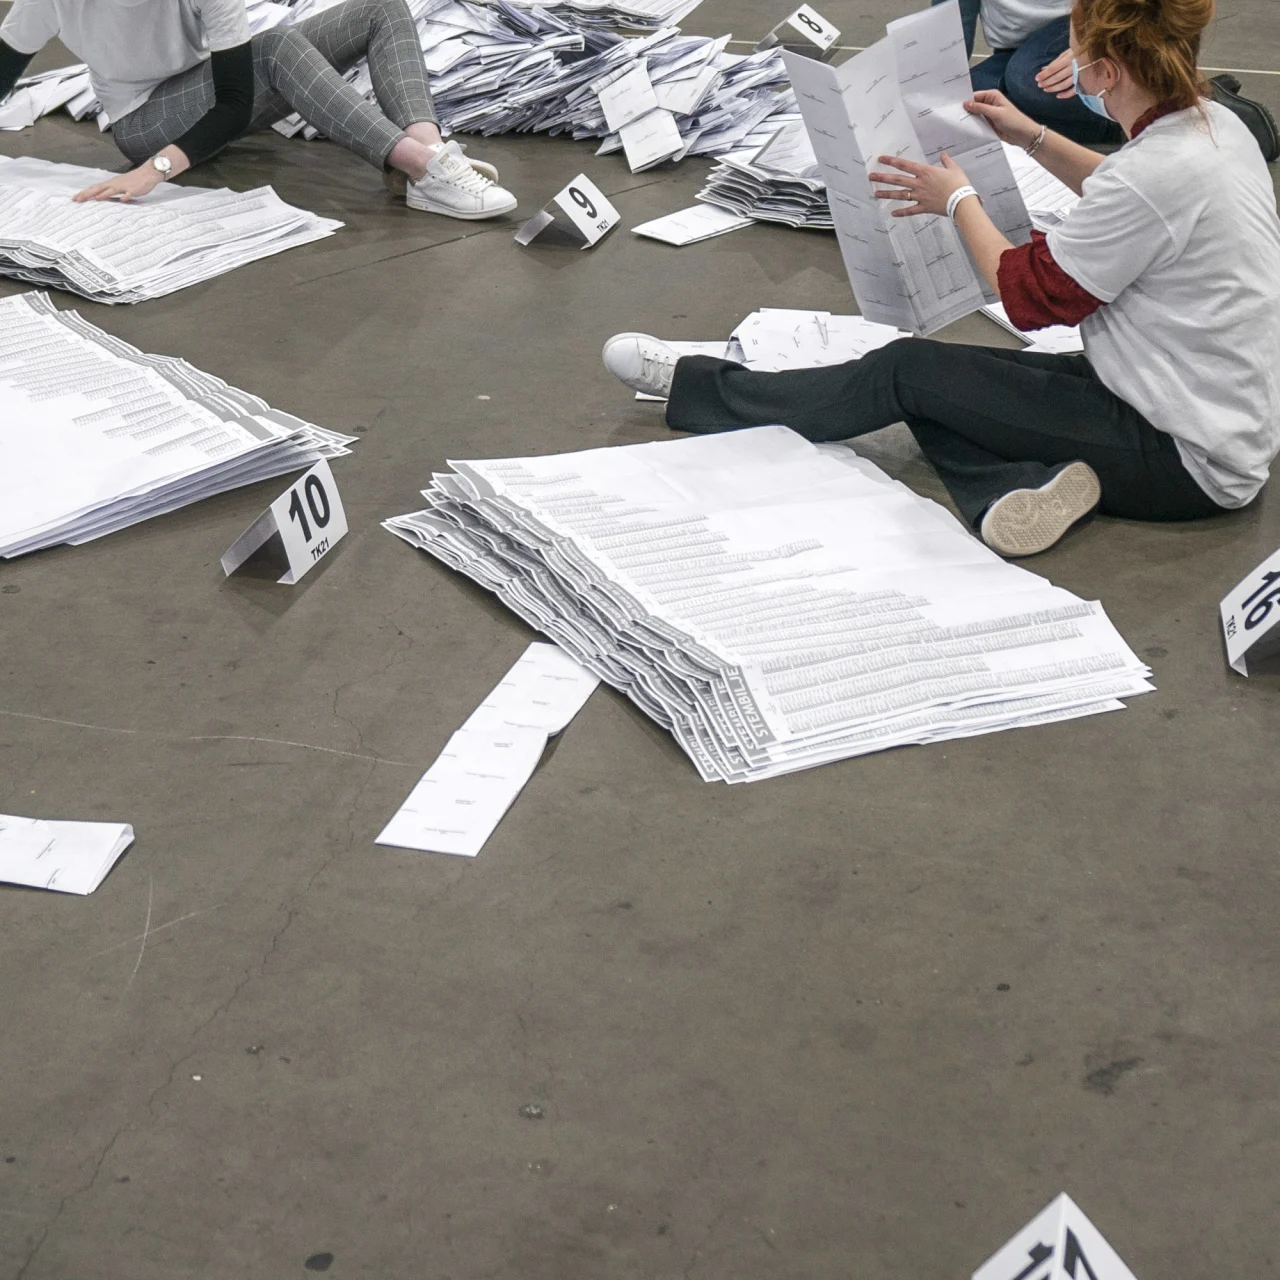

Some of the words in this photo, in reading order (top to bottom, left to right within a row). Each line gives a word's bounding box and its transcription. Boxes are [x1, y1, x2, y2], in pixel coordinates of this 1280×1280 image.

[797, 11, 824, 35] 8
[567, 186, 599, 220] 9
[596, 220, 611, 234] TK21
[288, 473, 332, 546] 10
[311, 537, 330, 561] TK21
[727, 665, 770, 739] STEMBILJE
